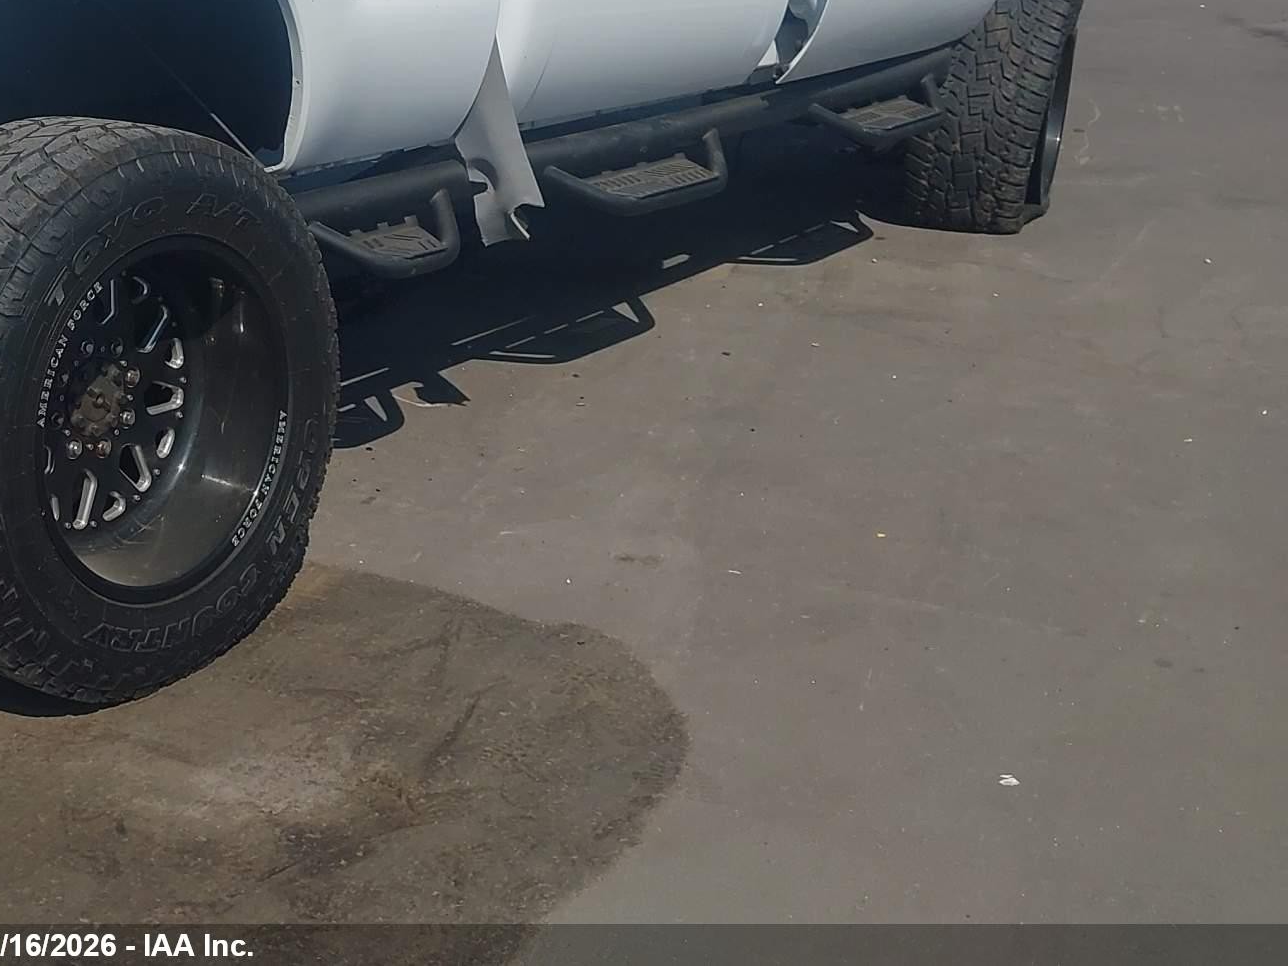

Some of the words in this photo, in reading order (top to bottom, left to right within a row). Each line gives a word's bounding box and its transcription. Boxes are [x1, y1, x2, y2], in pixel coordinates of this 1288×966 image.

[36, 334, 70, 428] AMERICAN
[66, 281, 104, 331] FORCE
[262, 410, 289, 495] AMERICAN
[231, 498, 264, 548] FORCE
